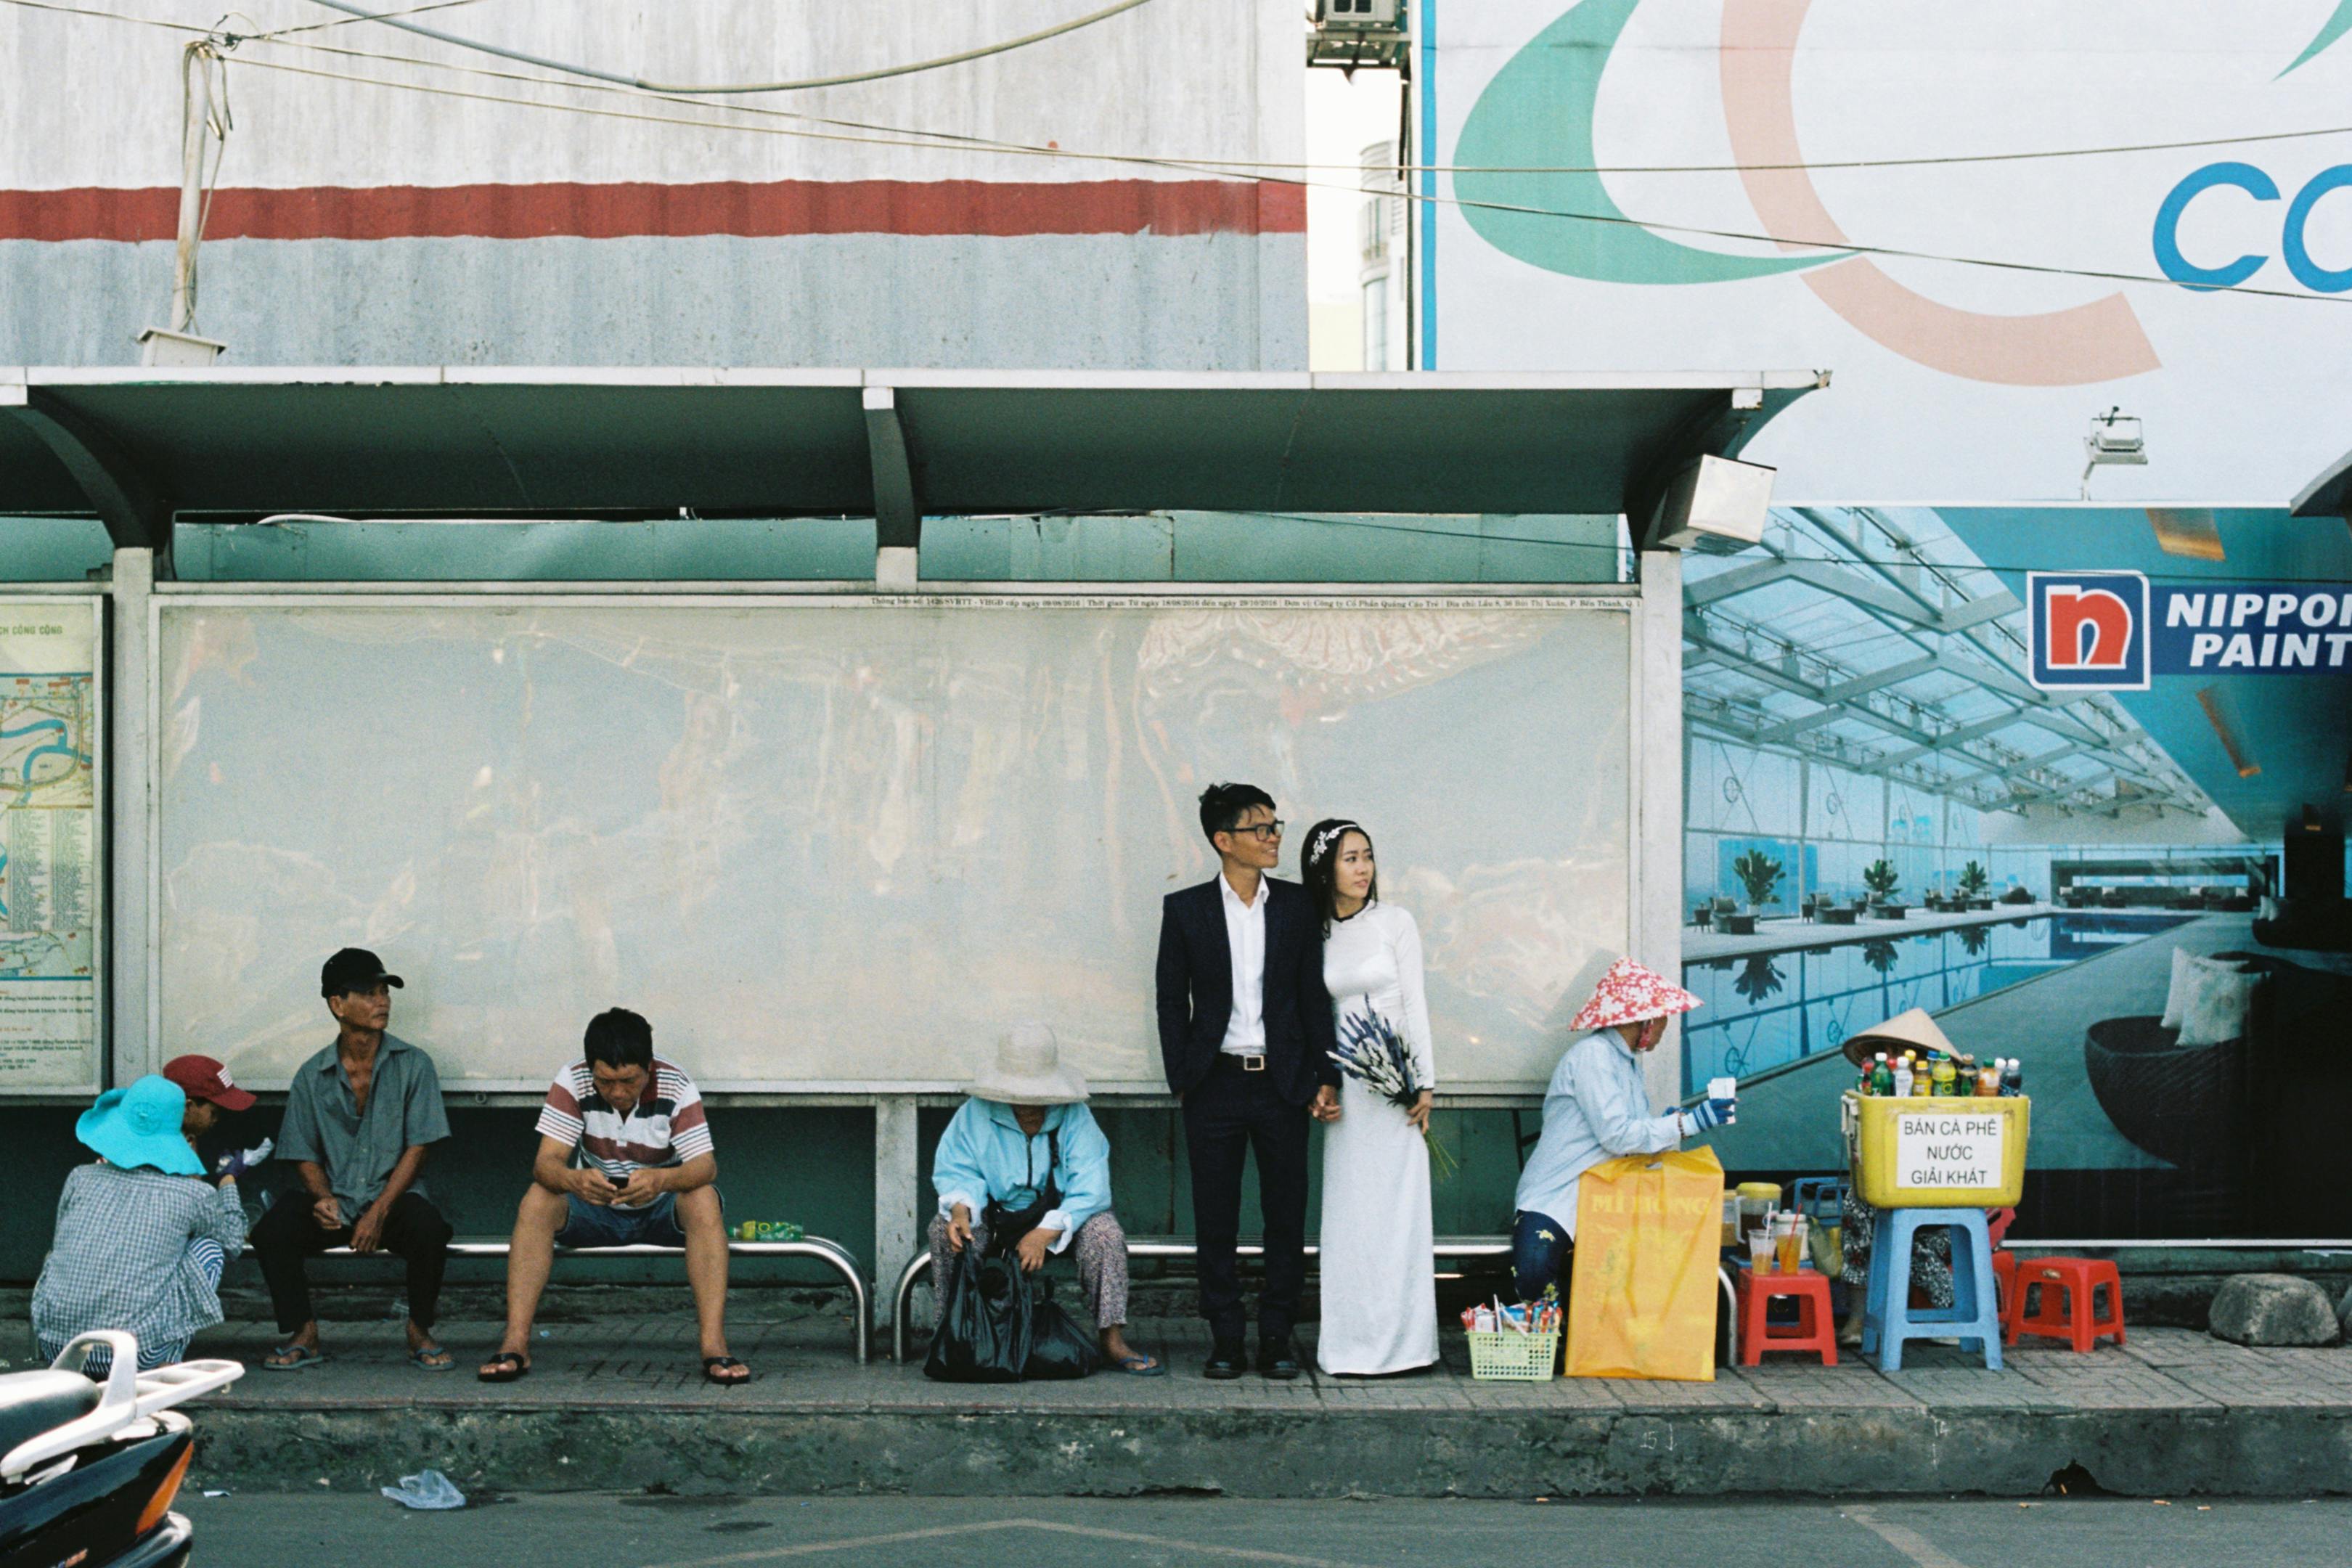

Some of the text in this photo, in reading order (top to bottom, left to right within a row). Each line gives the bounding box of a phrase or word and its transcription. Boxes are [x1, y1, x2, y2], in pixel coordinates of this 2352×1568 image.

[2189, 633, 2352, 667] PAINT
[1904, 1119, 1997, 1135] BÁN CÀ PHÊ
[1927, 1143, 1973, 1160] NƯỚC
[1911, 1167, 1988, 1185] GIẢI KHÁT
